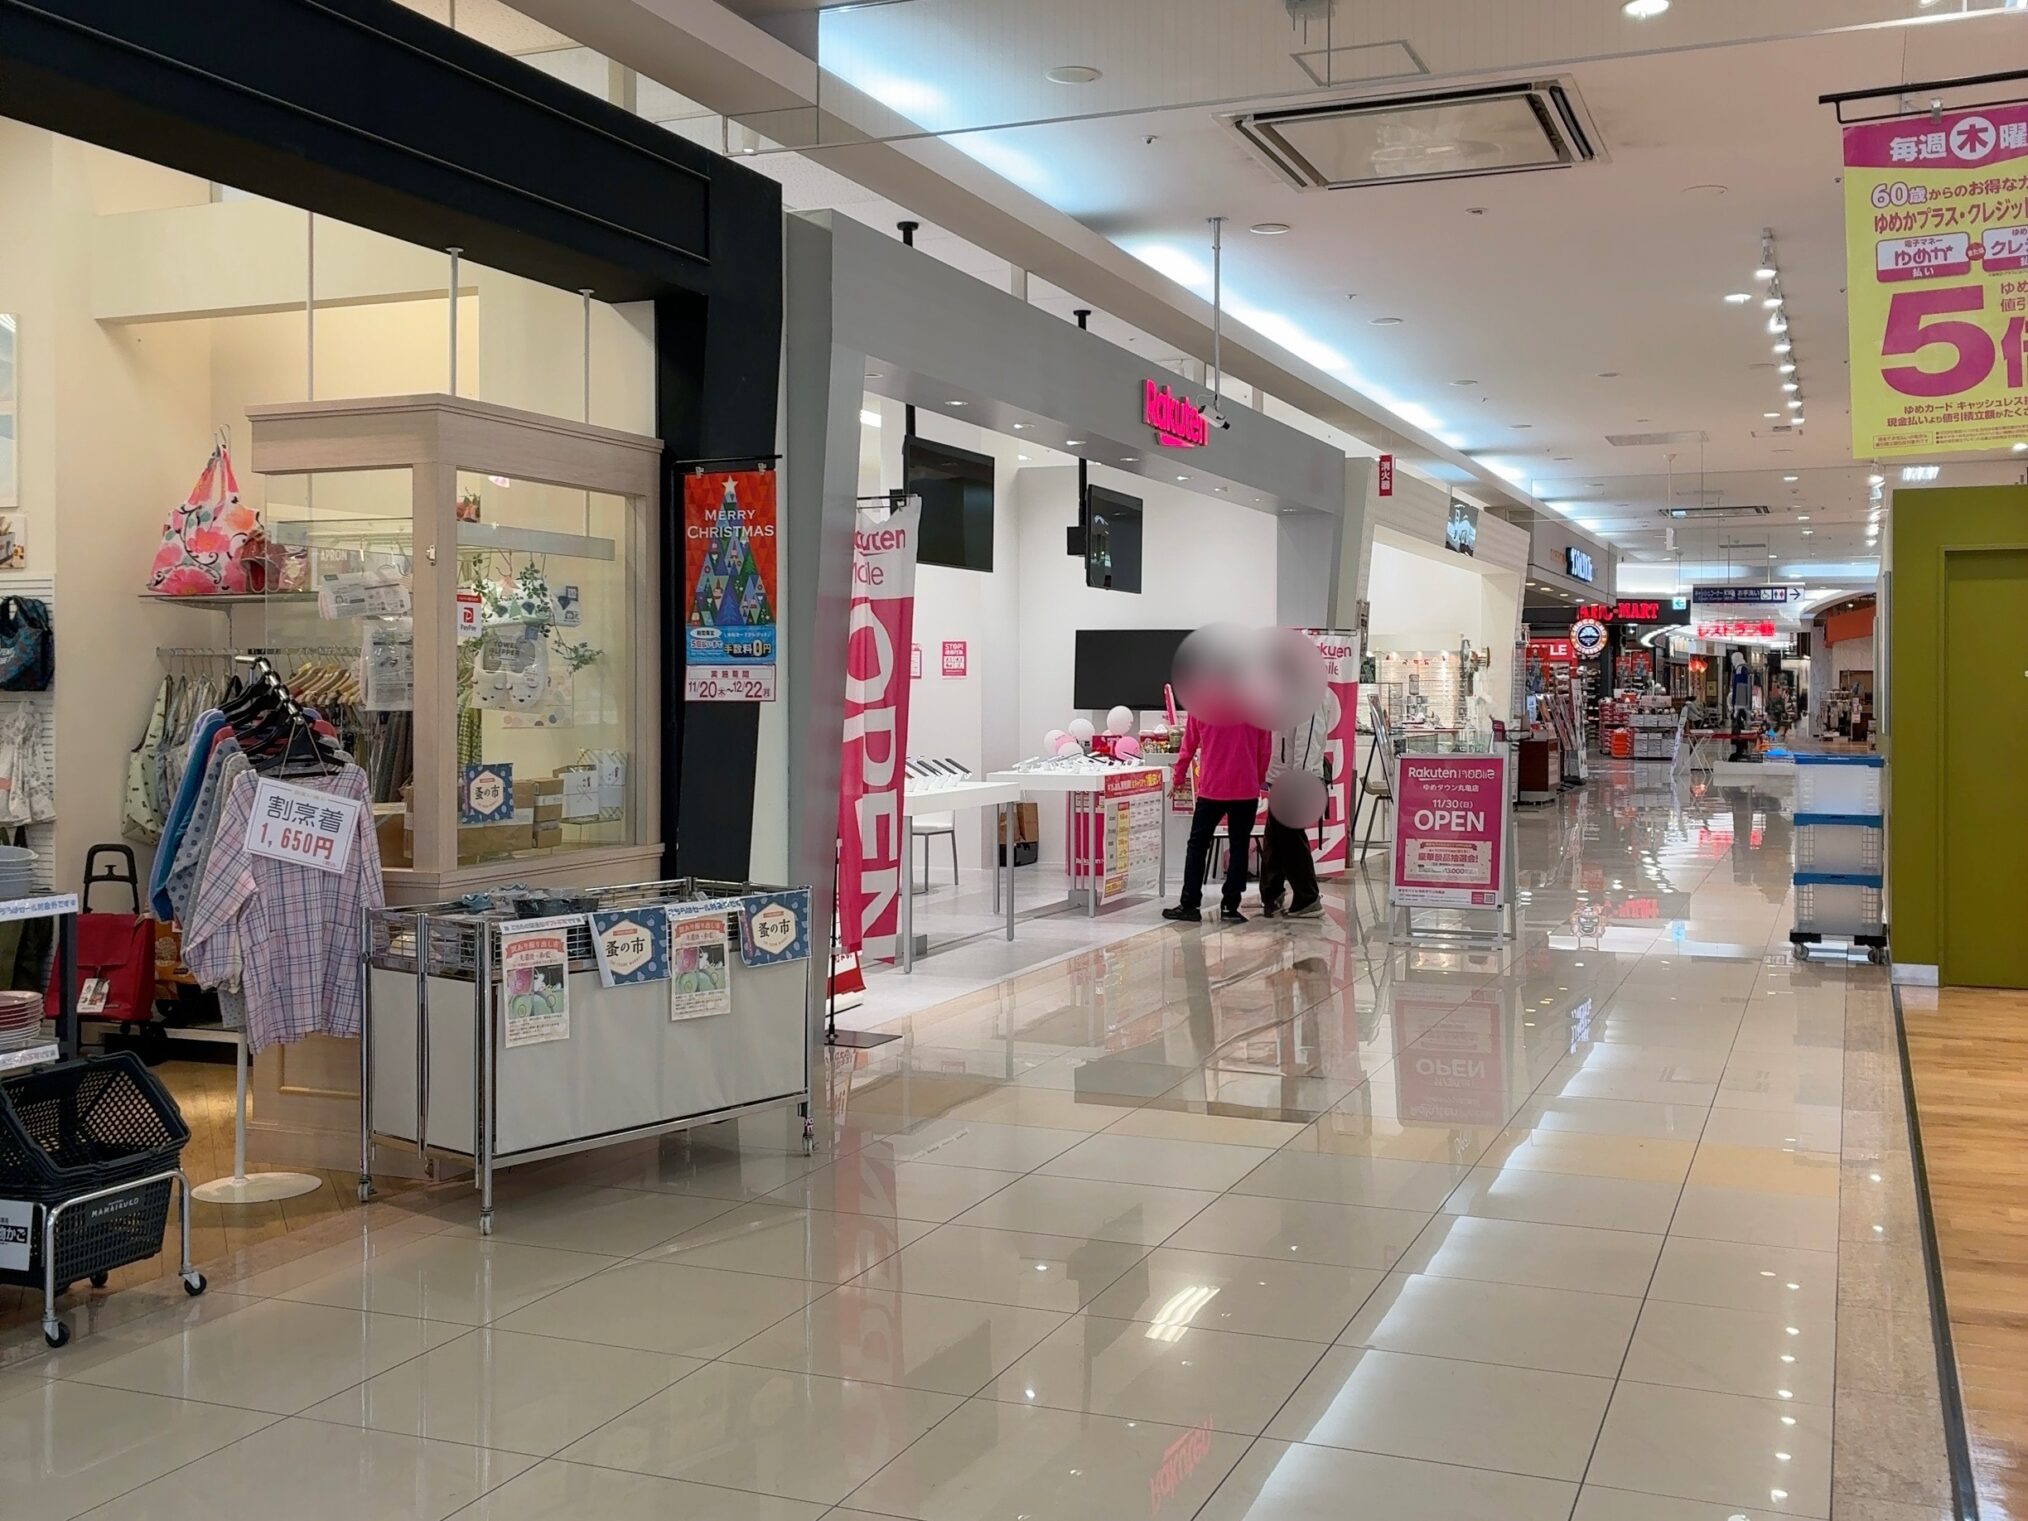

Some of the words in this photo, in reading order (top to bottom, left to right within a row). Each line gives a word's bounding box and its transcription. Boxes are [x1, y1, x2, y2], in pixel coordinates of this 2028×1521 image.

[1144, 378, 1209, 446] Rakuten
[704, 509, 756, 522] MERRY
[687, 525, 775, 539] CHRISTMAS
[724, 639, 771, 656] 手数料0円
[1408, 767, 1457, 781] Rakuten
[267, 795, 344, 834] 割烹着
[1414, 809, 1485, 832] OPEN
[758, 919, 790, 938] 蚤の市
[605, 937, 645, 957] 蚤の市
